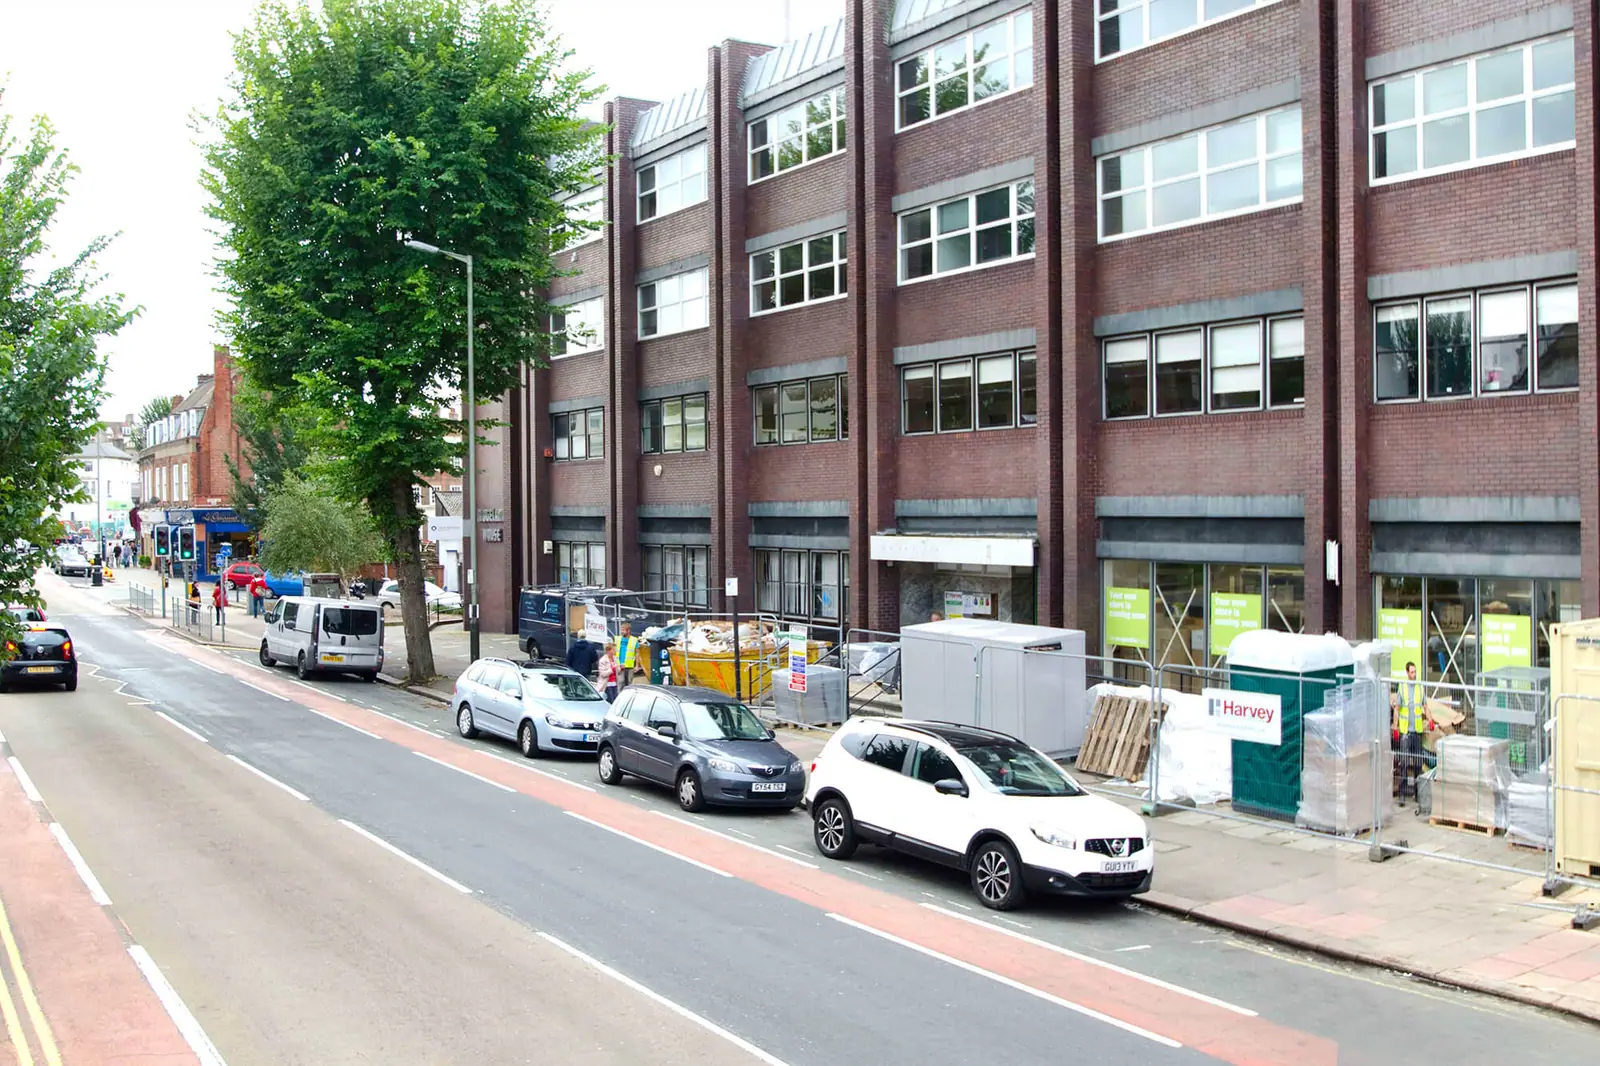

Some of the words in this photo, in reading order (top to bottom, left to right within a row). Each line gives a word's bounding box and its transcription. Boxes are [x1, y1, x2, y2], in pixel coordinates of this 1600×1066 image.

[1223, 699, 1275, 723] Harvey
[1105, 862, 1121, 871] GU13
[1123, 861, 1135, 870] YTV
